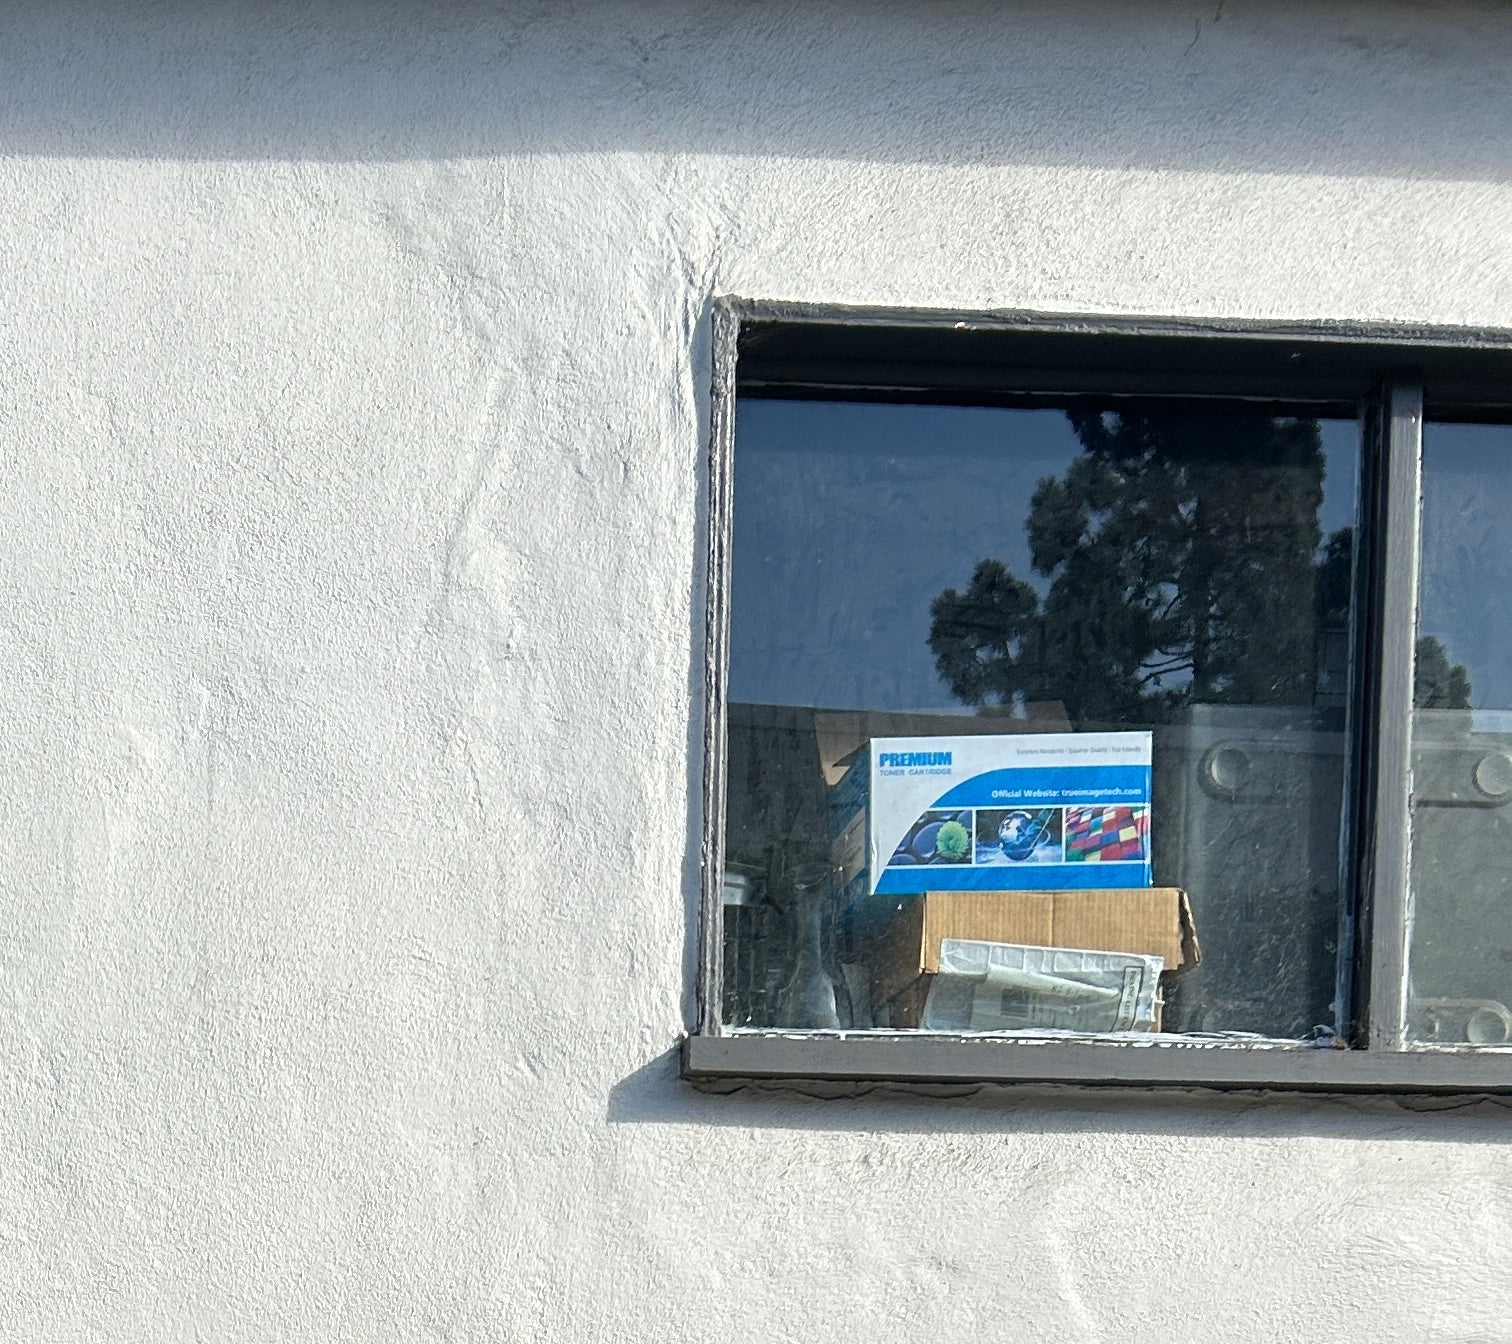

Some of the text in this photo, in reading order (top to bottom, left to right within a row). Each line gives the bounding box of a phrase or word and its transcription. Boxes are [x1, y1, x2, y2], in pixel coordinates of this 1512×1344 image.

[879, 752, 952, 767] PREMIUM
[991, 789, 1022, 798] Official
[1023, 789, 1060, 798] Website:
